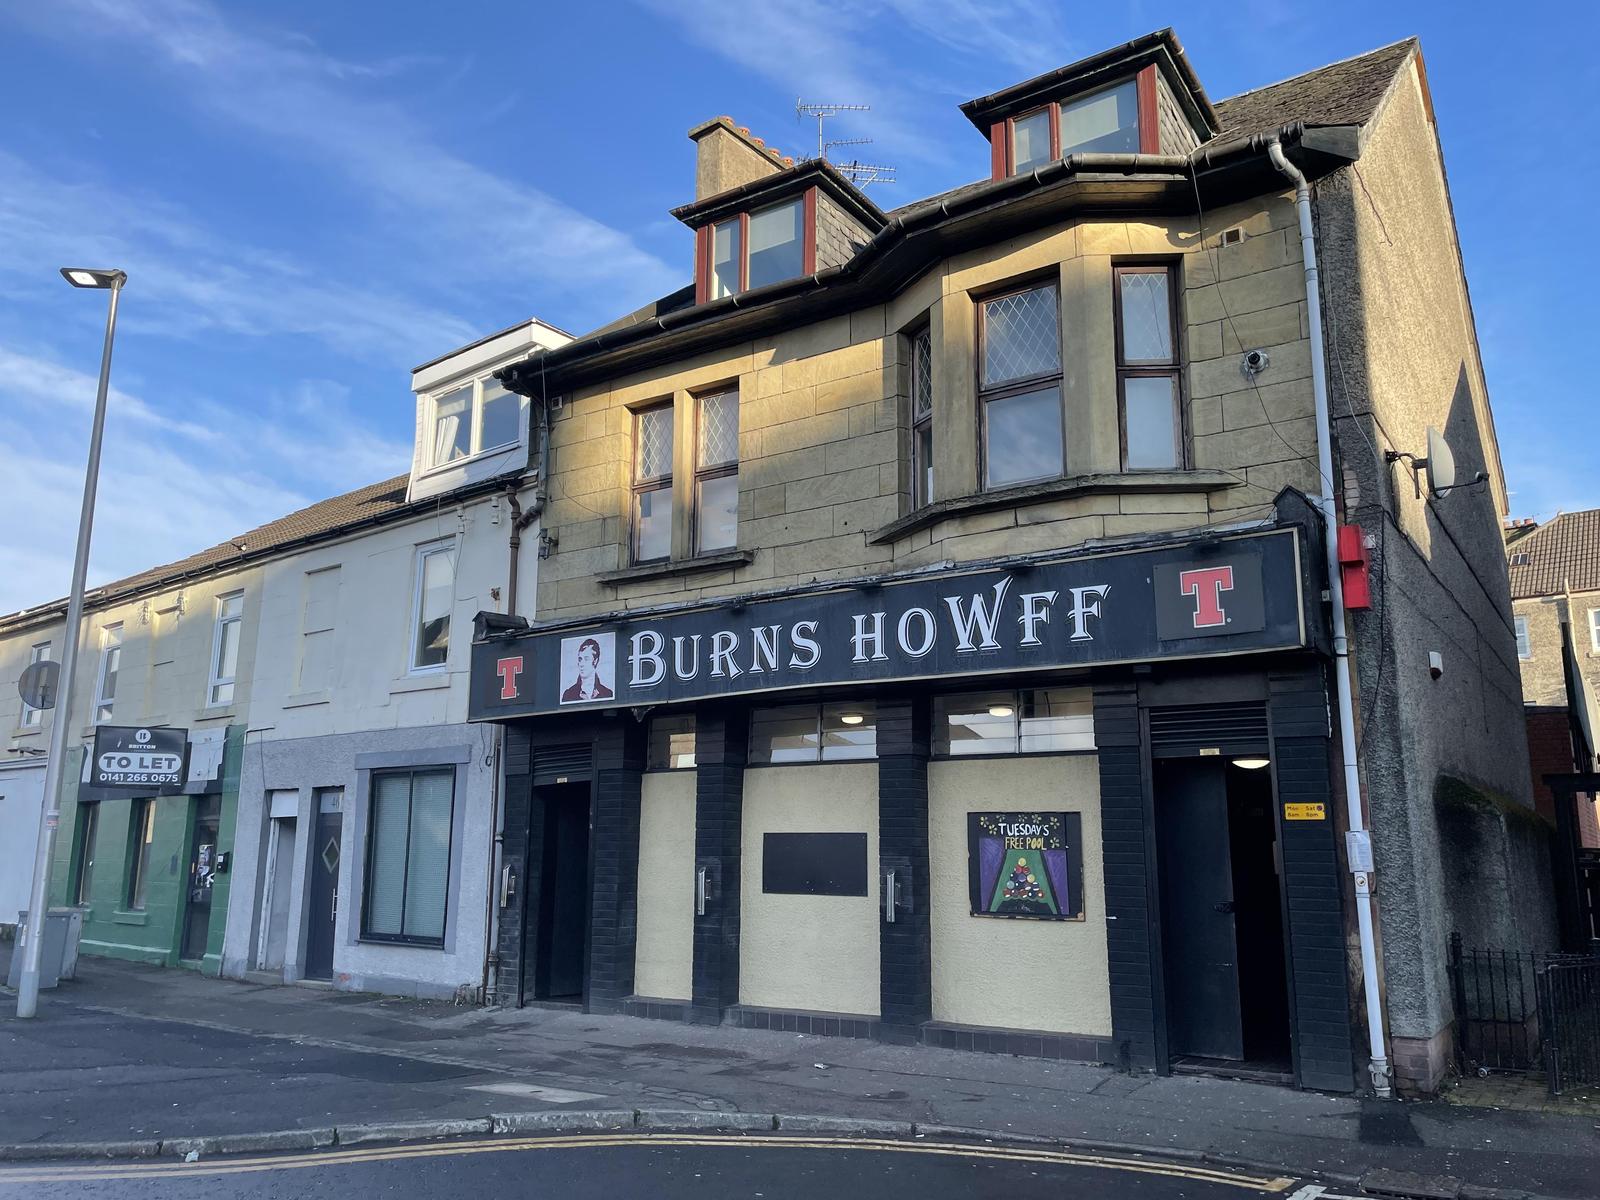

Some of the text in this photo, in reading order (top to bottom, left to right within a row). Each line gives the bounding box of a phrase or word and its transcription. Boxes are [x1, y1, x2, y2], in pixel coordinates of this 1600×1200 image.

[1180, 565, 1233, 630] T
[628, 575, 1113, 689] BURNS HOWFF
[496, 655, 523, 700] T
[103, 756, 176, 770] TO LET
[99, 773, 178, 782] 0141 266 0675
[998, 823, 1050, 836] TUESDAY'S
[1005, 837, 1047, 850] FREE POOL
